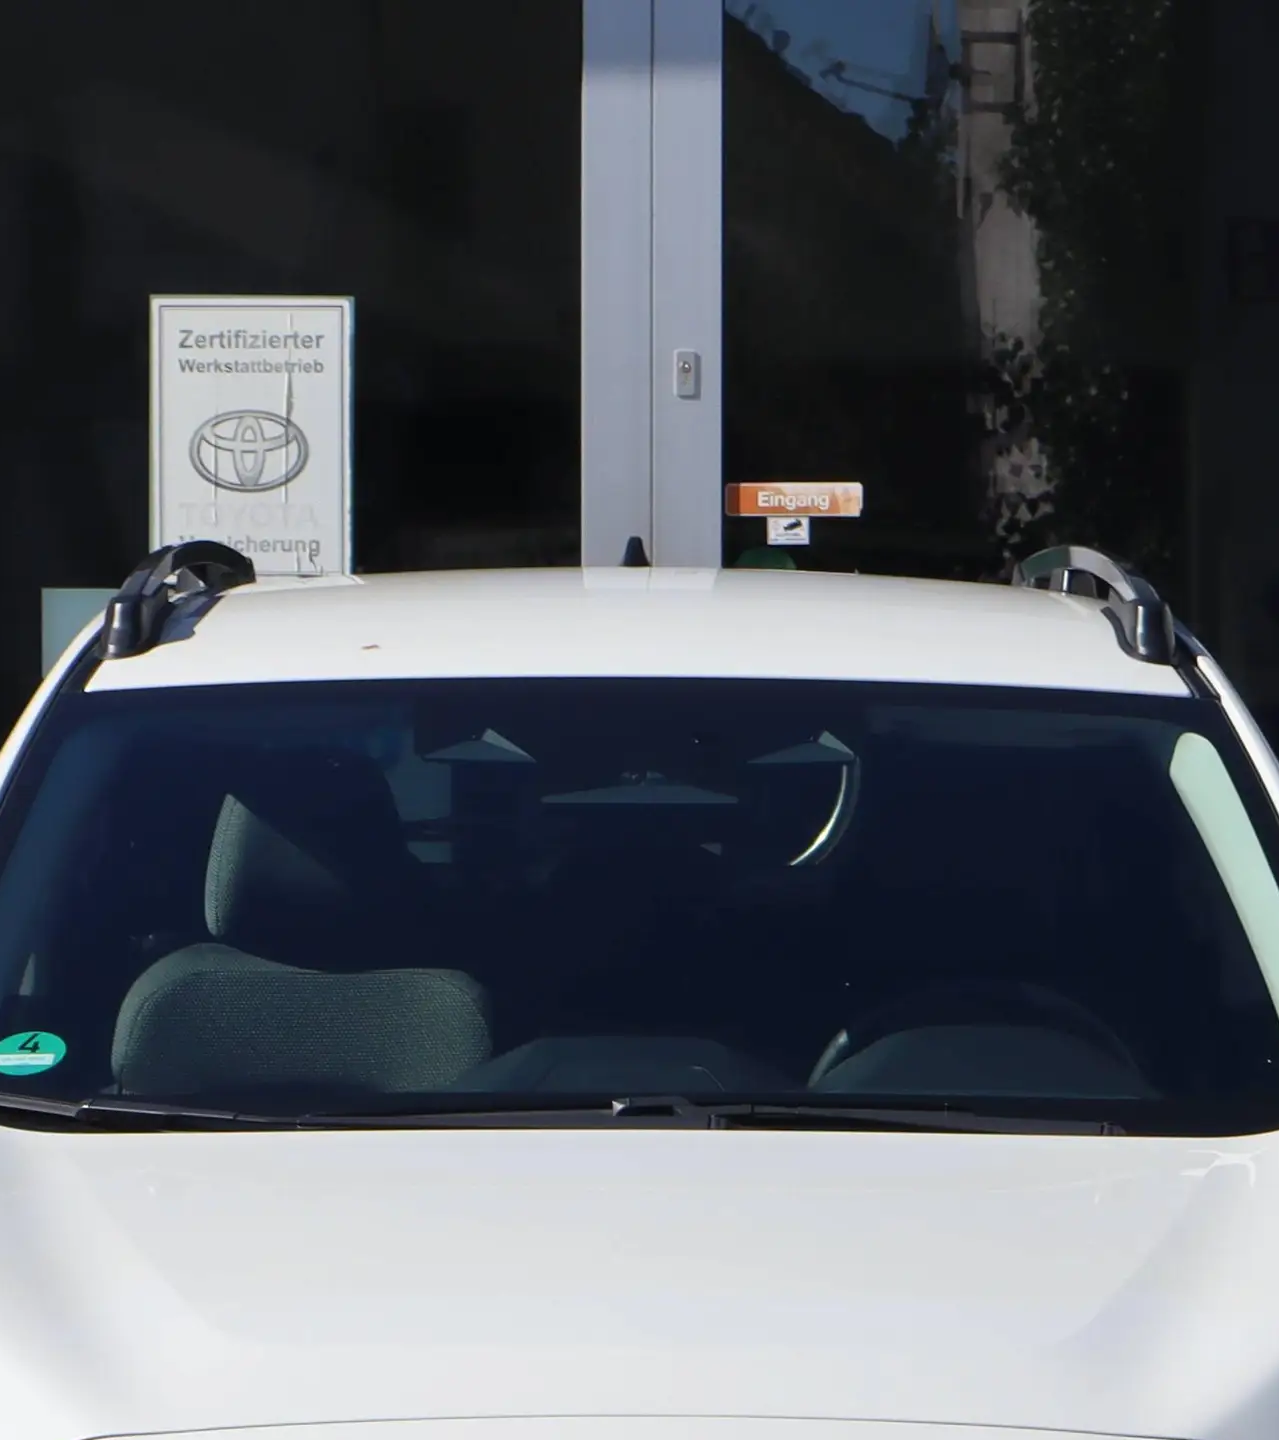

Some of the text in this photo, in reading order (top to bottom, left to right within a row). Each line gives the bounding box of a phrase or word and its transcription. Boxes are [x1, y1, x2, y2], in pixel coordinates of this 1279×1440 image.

[178, 329, 325, 350] Zertifizierter
[178, 359, 325, 375] Werkstattbetrieb
[756, 491, 829, 511] Eingang
[17, 1032, 41, 1053] 4
